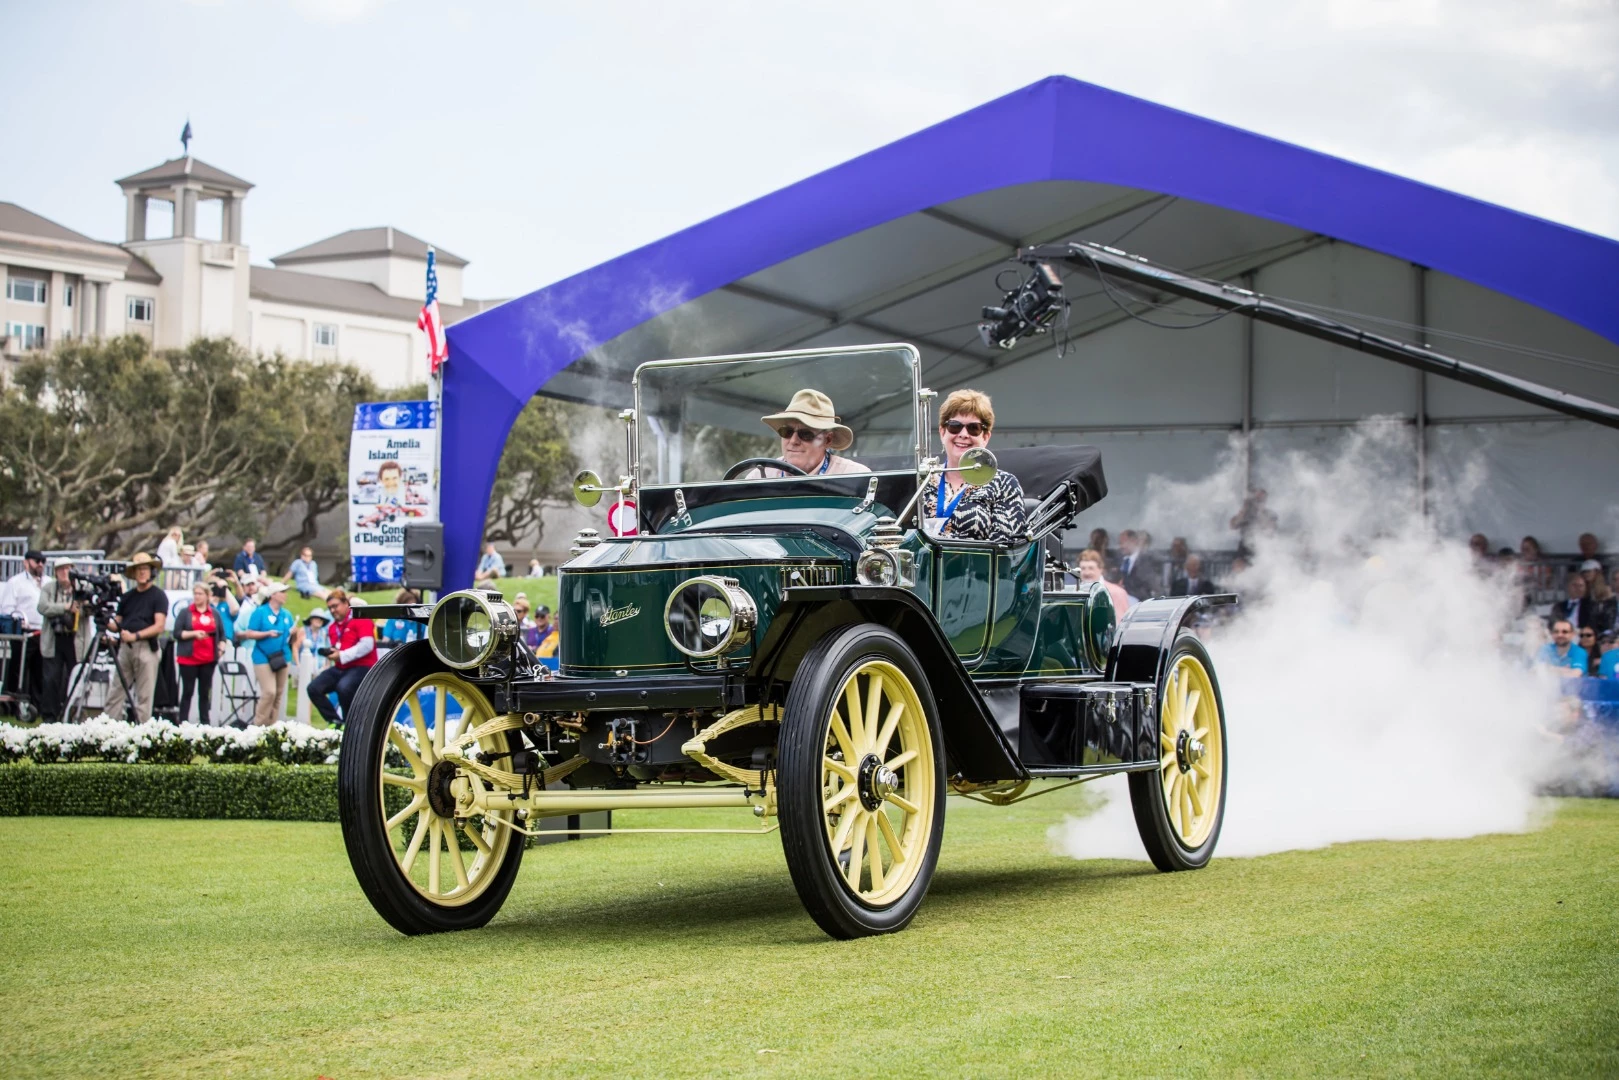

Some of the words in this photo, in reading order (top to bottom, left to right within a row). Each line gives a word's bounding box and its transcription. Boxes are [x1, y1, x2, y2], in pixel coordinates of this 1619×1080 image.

[386, 439, 420, 448] Amelia
[368, 450, 399, 460] Island
[354, 533, 404, 545] d'Eleganc
[600, 602, 641, 627] Stanley
